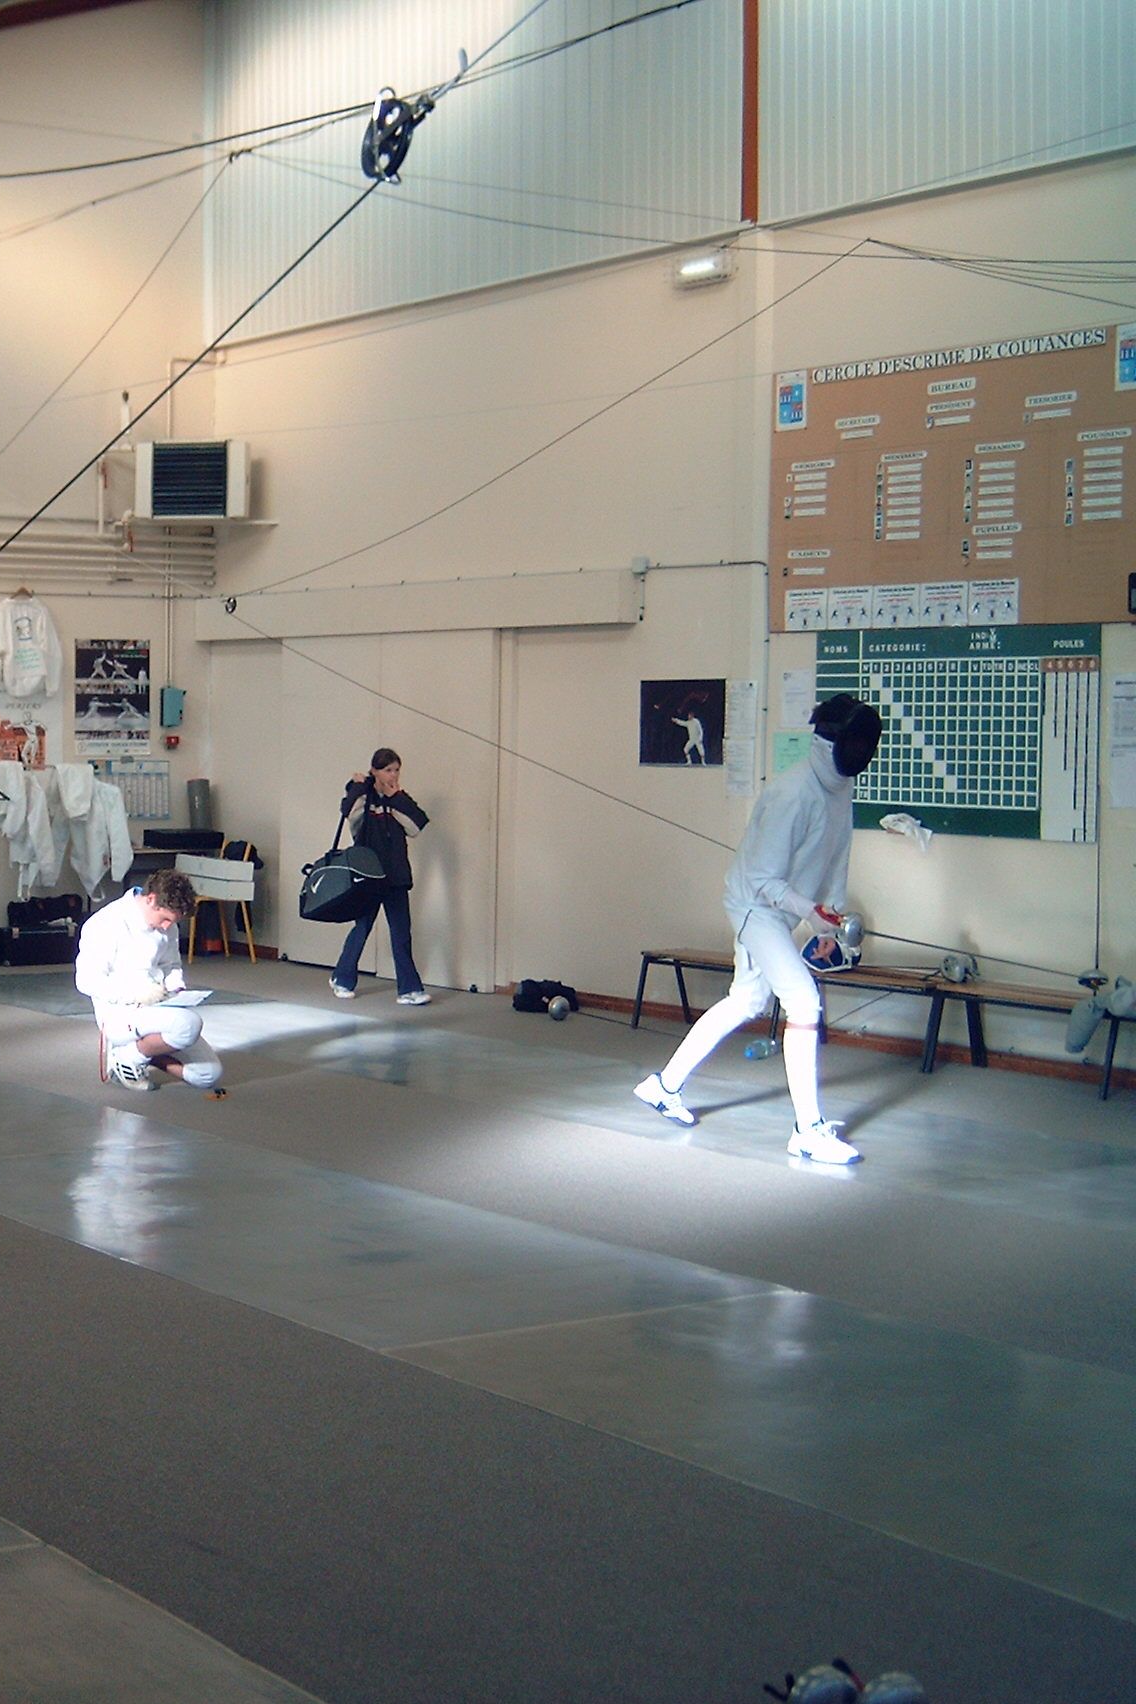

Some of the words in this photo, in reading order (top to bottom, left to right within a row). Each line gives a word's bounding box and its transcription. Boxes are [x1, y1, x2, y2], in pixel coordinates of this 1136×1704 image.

[813, 360, 874, 383] CERCLE
[878, 348, 965, 375] D'ESCRIME
[970, 344, 992, 362] DE
[997, 329, 1105, 358] COUTANCES
[931, 379, 972, 393] BUREAU
[824, 645, 848, 653] NOMS
[1053, 639, 1085, 648] POULES
